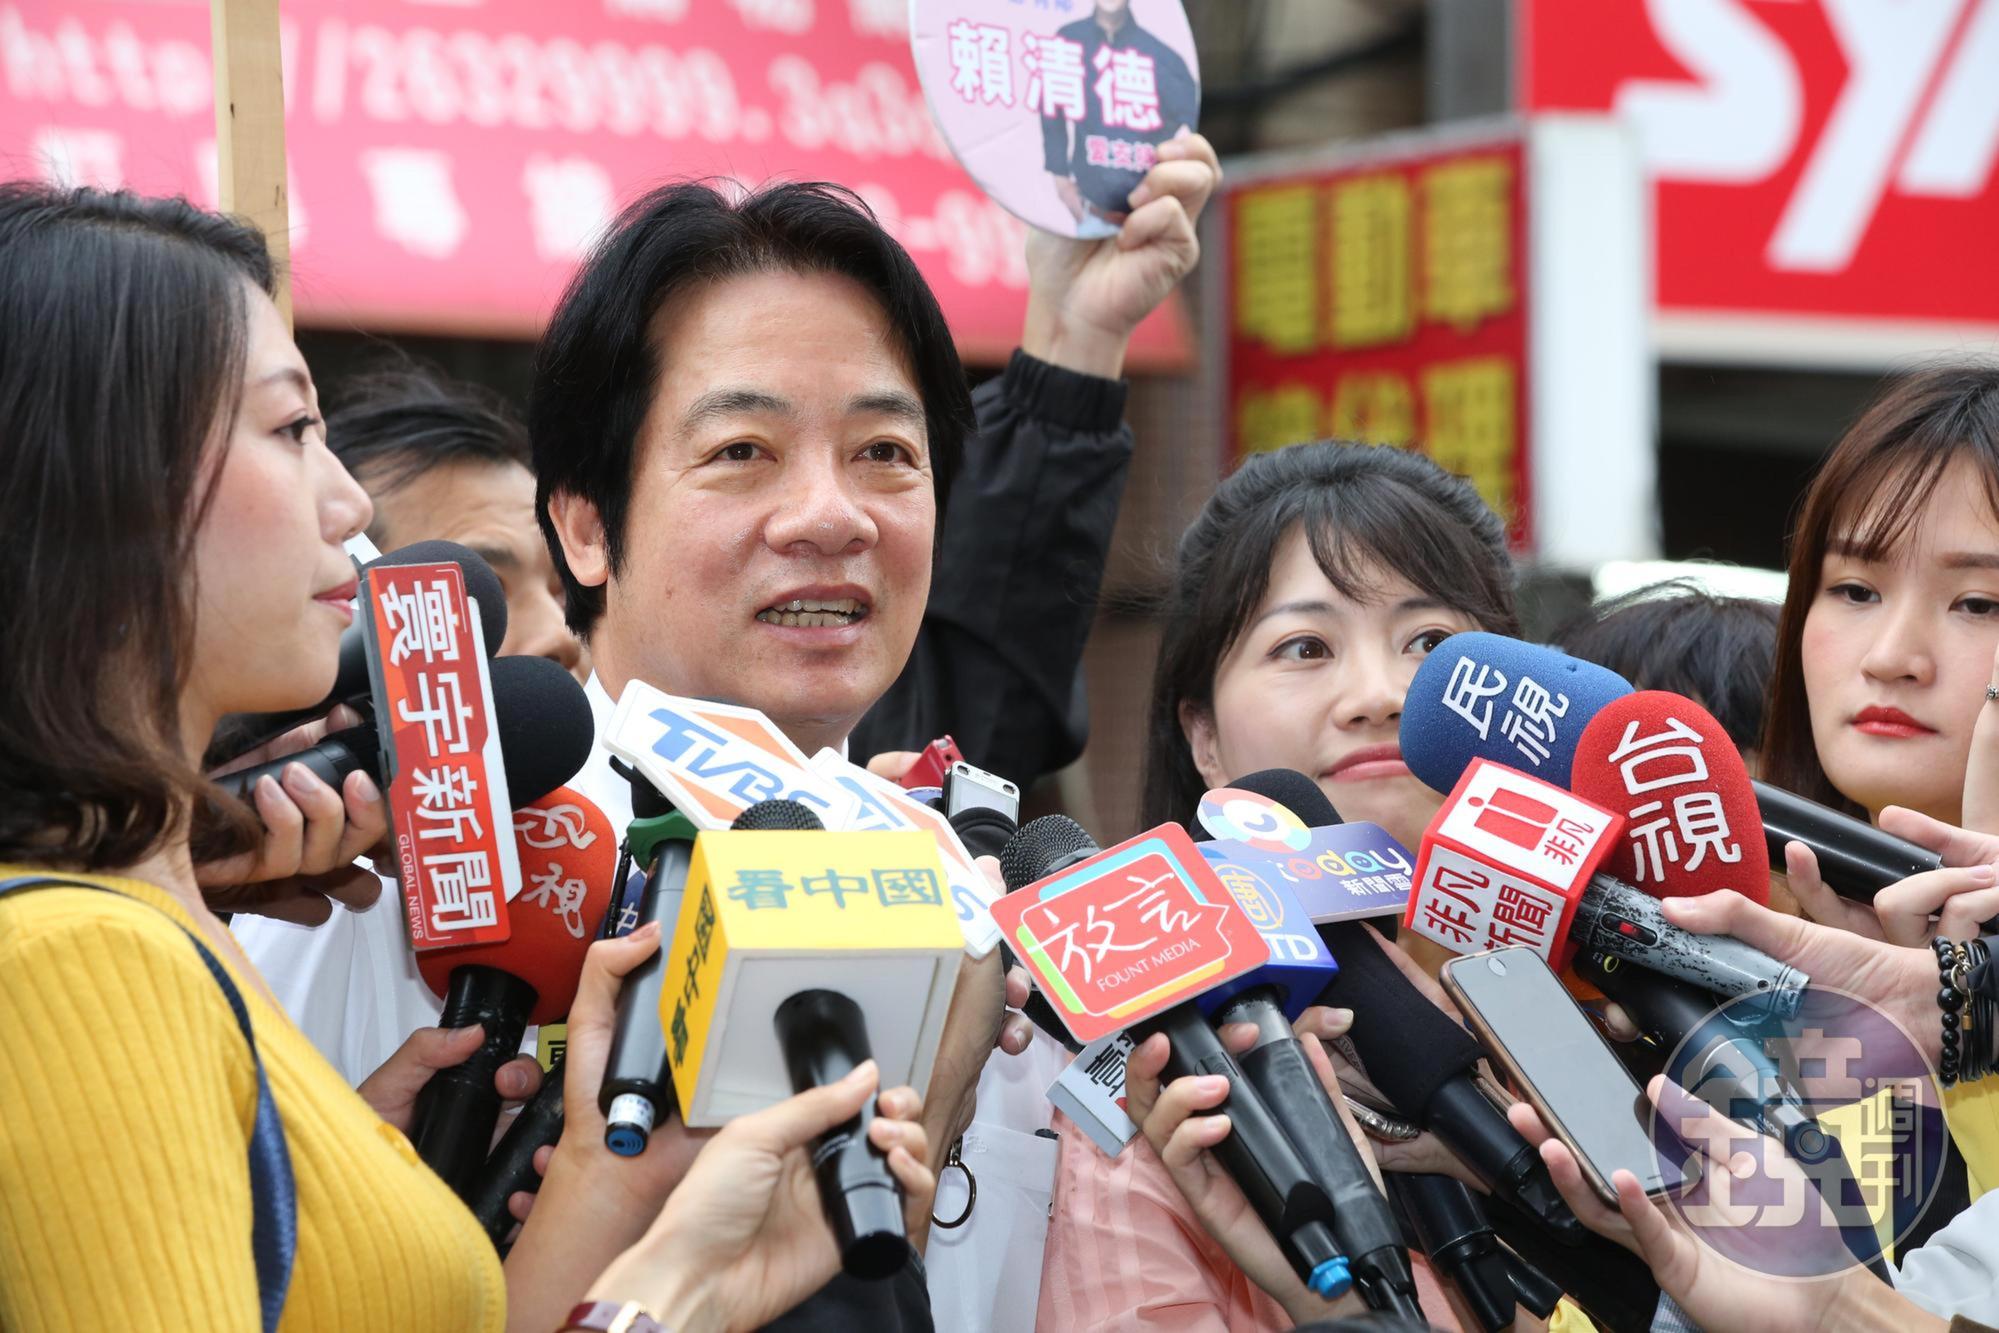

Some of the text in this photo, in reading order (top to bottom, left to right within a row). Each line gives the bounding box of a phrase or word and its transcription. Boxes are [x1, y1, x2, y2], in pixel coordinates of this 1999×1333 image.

[948, 18, 1163, 131] 賴清德
[379, 580, 498, 932] 寰宇新聞
[1442, 655, 1570, 766] 民視
[1544, 818, 1595, 865] 非凡
[1608, 717, 1742, 882] 台視
[399, 834, 424, 939] GLOBAL NEWS
[727, 867, 943, 910] 看中國
[1027, 873, 1201, 984] 放言
[1340, 873, 1412, 896] 新聞雲
[1424, 866, 1490, 943] 非凡
[1096, 938, 1201, 992] FOUNT MEDIA
[1262, 932, 1318, 961] TD
